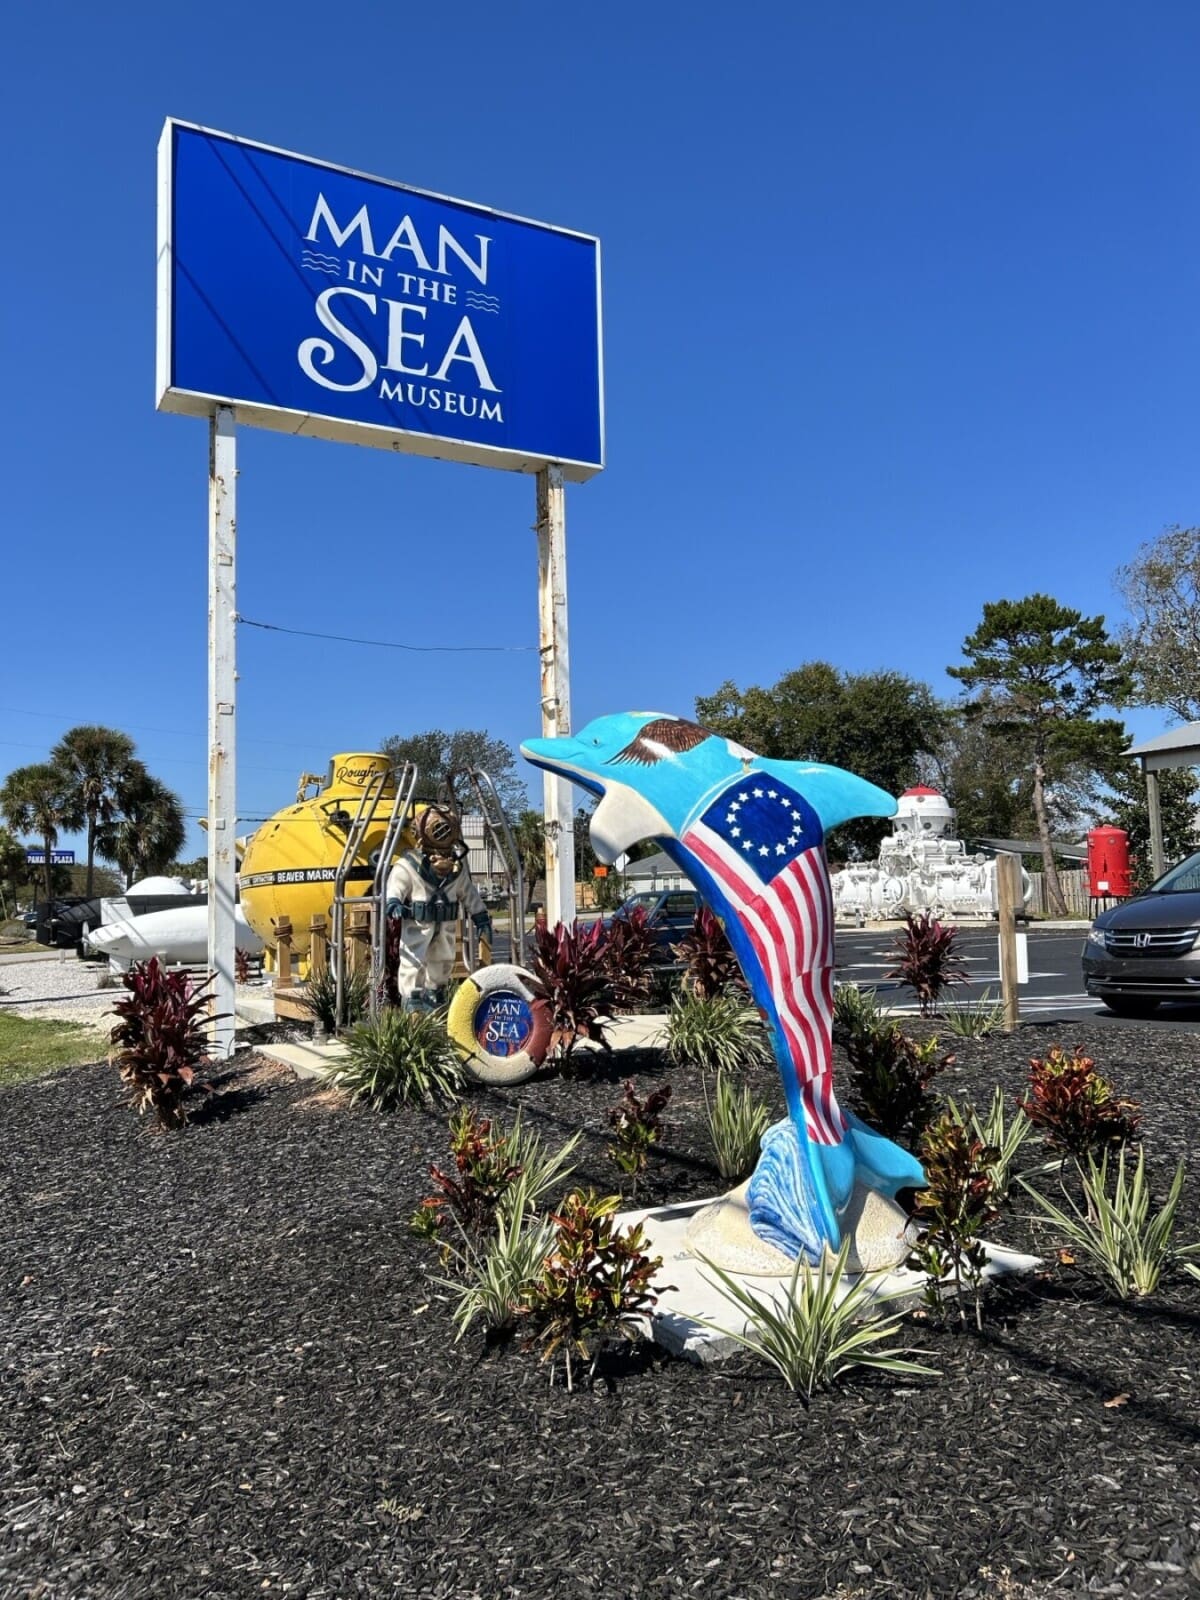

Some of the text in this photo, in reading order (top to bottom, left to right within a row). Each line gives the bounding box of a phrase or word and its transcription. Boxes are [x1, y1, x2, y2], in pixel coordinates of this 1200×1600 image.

[303, 191, 492, 286] MAN
[346, 260, 457, 305] IN THE
[297, 286, 503, 393] SEA
[378, 378, 504, 423] MUSEUM
[277, 871, 304, 883] BEAVER
[306, 869, 335, 881] MARK
[486, 1020, 520, 1042] SEA
[488, 1002, 520, 1015] MAN
